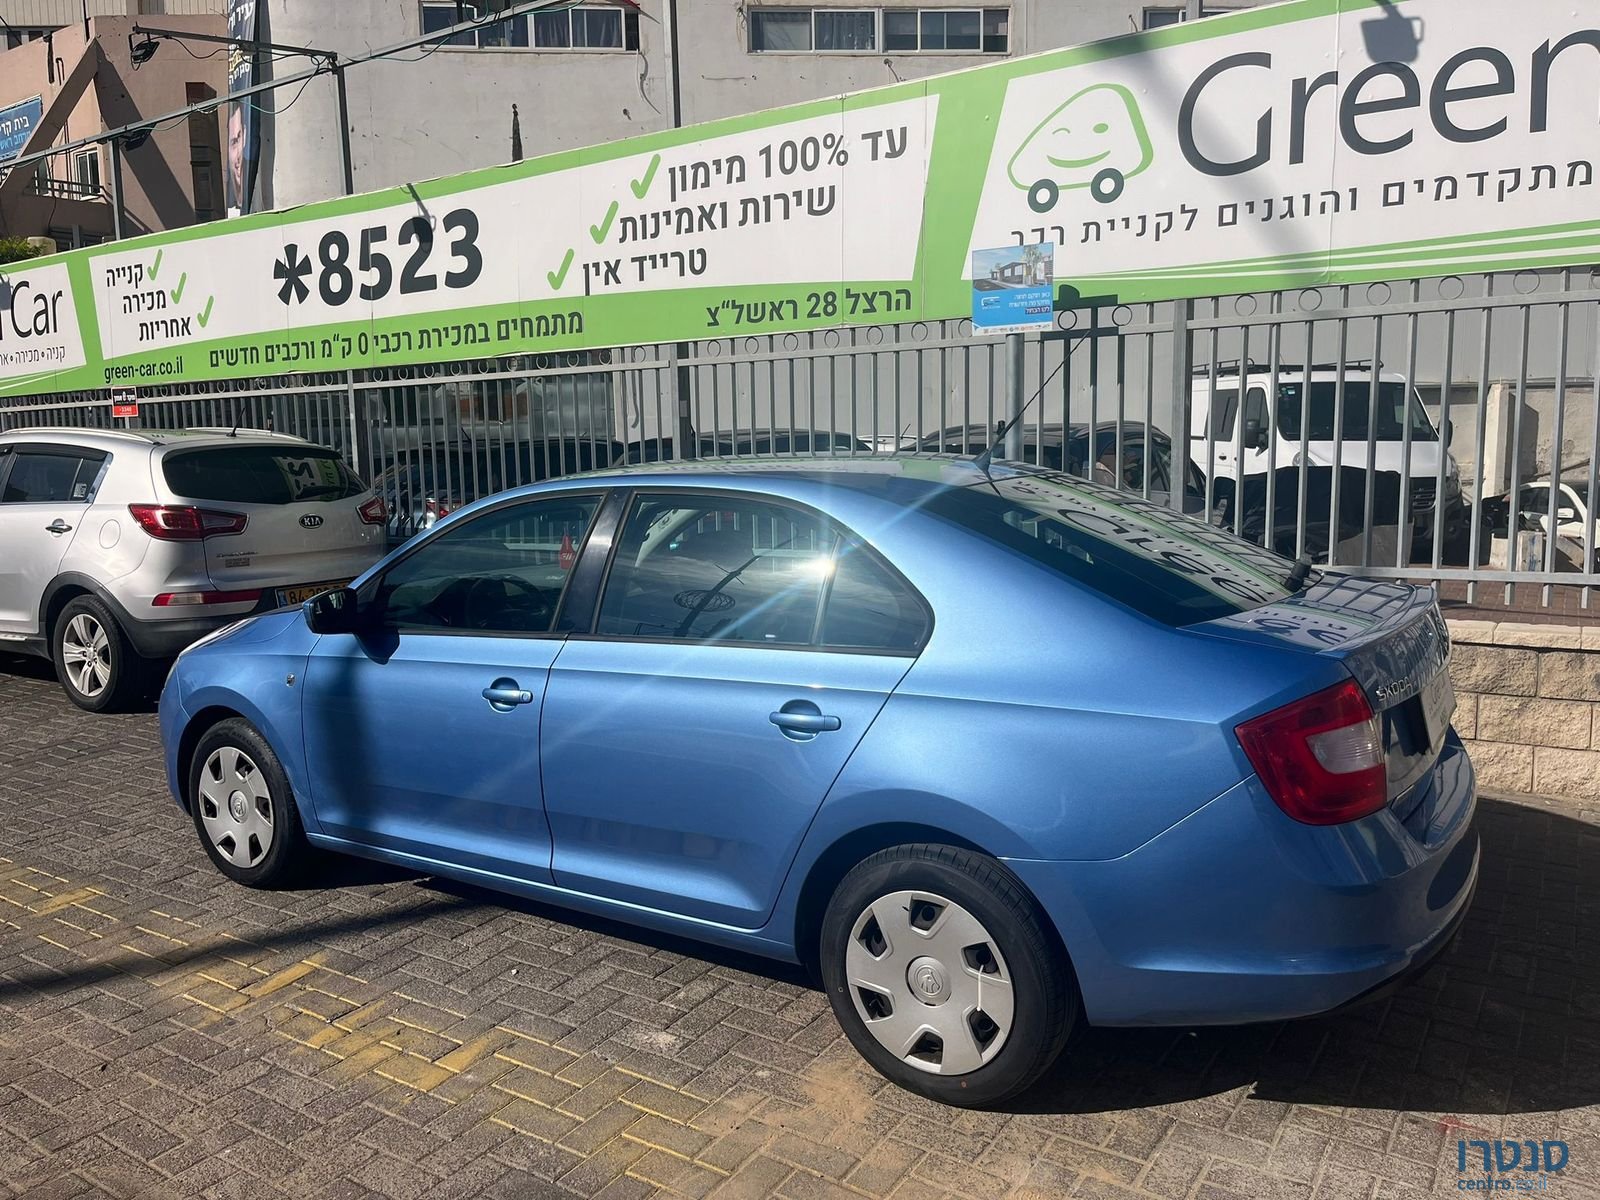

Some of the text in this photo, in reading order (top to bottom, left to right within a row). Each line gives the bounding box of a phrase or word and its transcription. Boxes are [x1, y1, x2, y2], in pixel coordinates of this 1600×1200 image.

[1178, 28, 1600, 176] Green
[14, 115, 30, 131] בית
[668, 126, 907, 202] עד 100% מימון
[1383, 160, 1592, 207] מתקדמים
[619, 185, 836, 243] שירות ואמינות
[1218, 187, 1357, 227] והוגנים
[1080, 204, 1198, 243] לקניית
[106, 263, 143, 289] קנייה
[583, 247, 707, 296] טרייד אין
[11, 280, 63, 338] Car
[123, 289, 167, 314] מכירה
[806, 291, 837, 318] 28
[845, 288, 911, 315] הרצל
[139, 316, 192, 341] אחריות
[418, 322, 490, 349] במכירת
[496, 311, 583, 341] מתמחים
[46, 345, 66, 363] קניה
[265, 340, 315, 363] ורכבים
[358, 332, 369, 355] 0
[374, 331, 412, 353] רכבי
[15, 349, 39, 364] מכירה
[104, 356, 183, 384] green-car.co.il
[209, 346, 260, 367] חדשים
[303, 516, 322, 526] KIA
